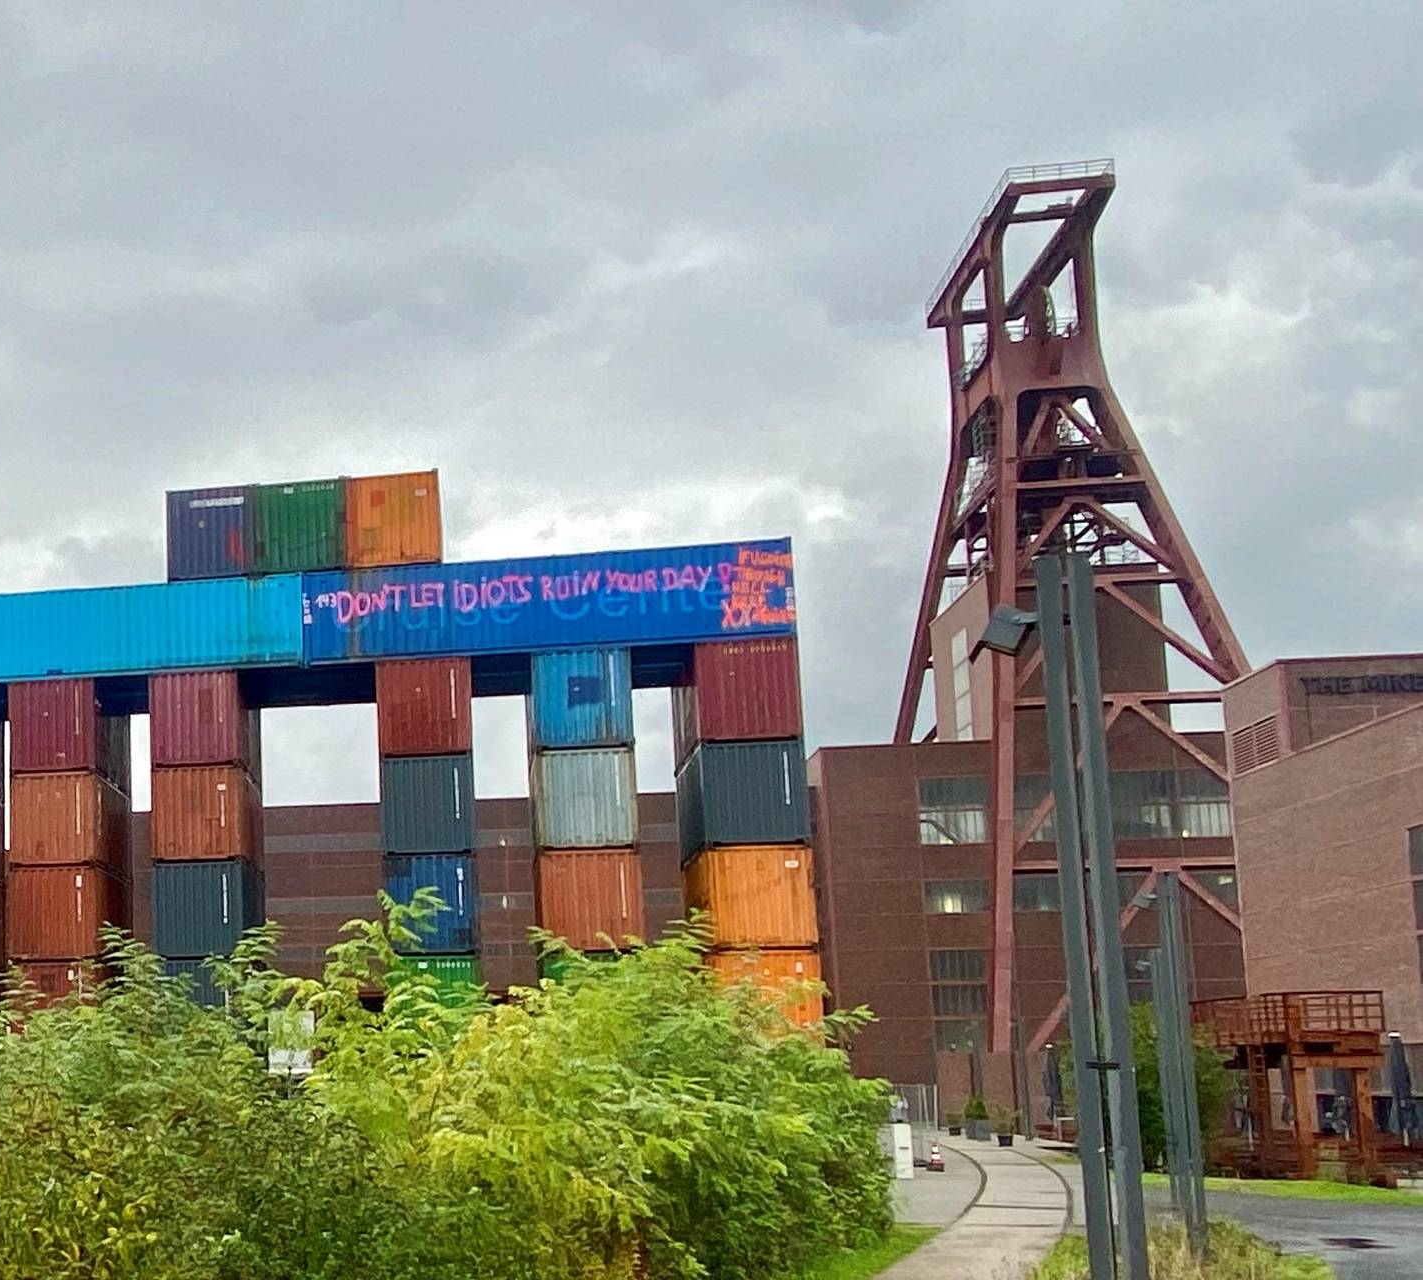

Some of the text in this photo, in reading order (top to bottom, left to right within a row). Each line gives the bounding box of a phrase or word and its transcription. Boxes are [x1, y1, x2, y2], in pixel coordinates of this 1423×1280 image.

[336, 583, 407, 624] DON'T
[409, 582, 445, 608] LET
[605, 567, 657, 594] YOUR
[1300, 676, 1354, 695] THE
